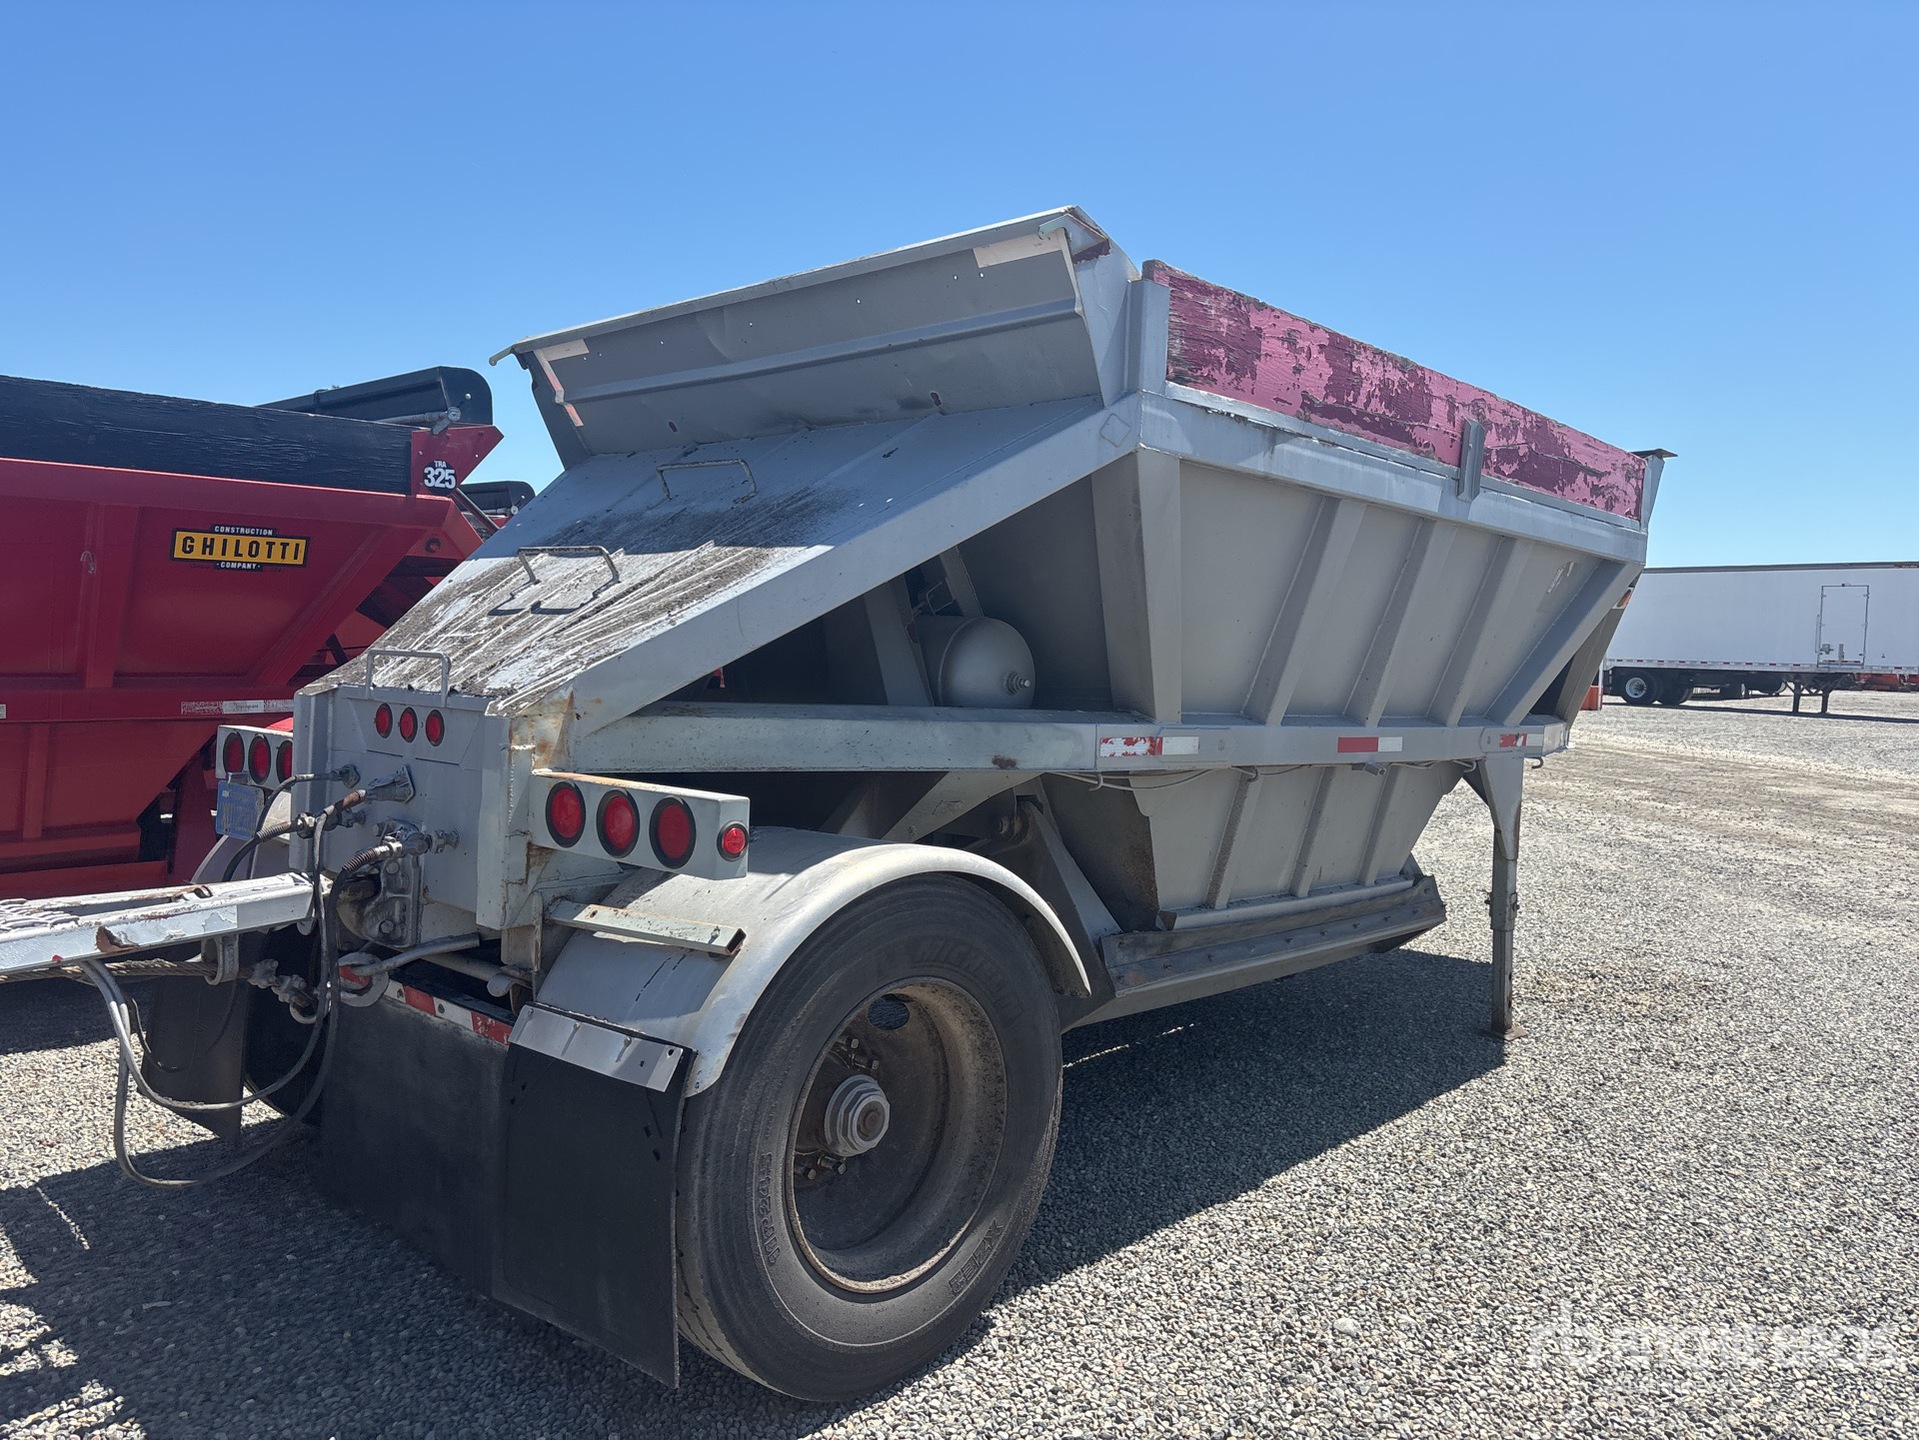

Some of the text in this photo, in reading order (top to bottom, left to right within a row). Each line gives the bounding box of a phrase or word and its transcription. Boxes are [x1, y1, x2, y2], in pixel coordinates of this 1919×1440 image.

[434, 460, 447, 468] TRA
[424, 466, 456, 489] 325
[214, 525, 273, 536] CONSTRUCTION
[181, 536, 300, 560] GHILOTTI
[220, 561, 257, 570] COMPANY
